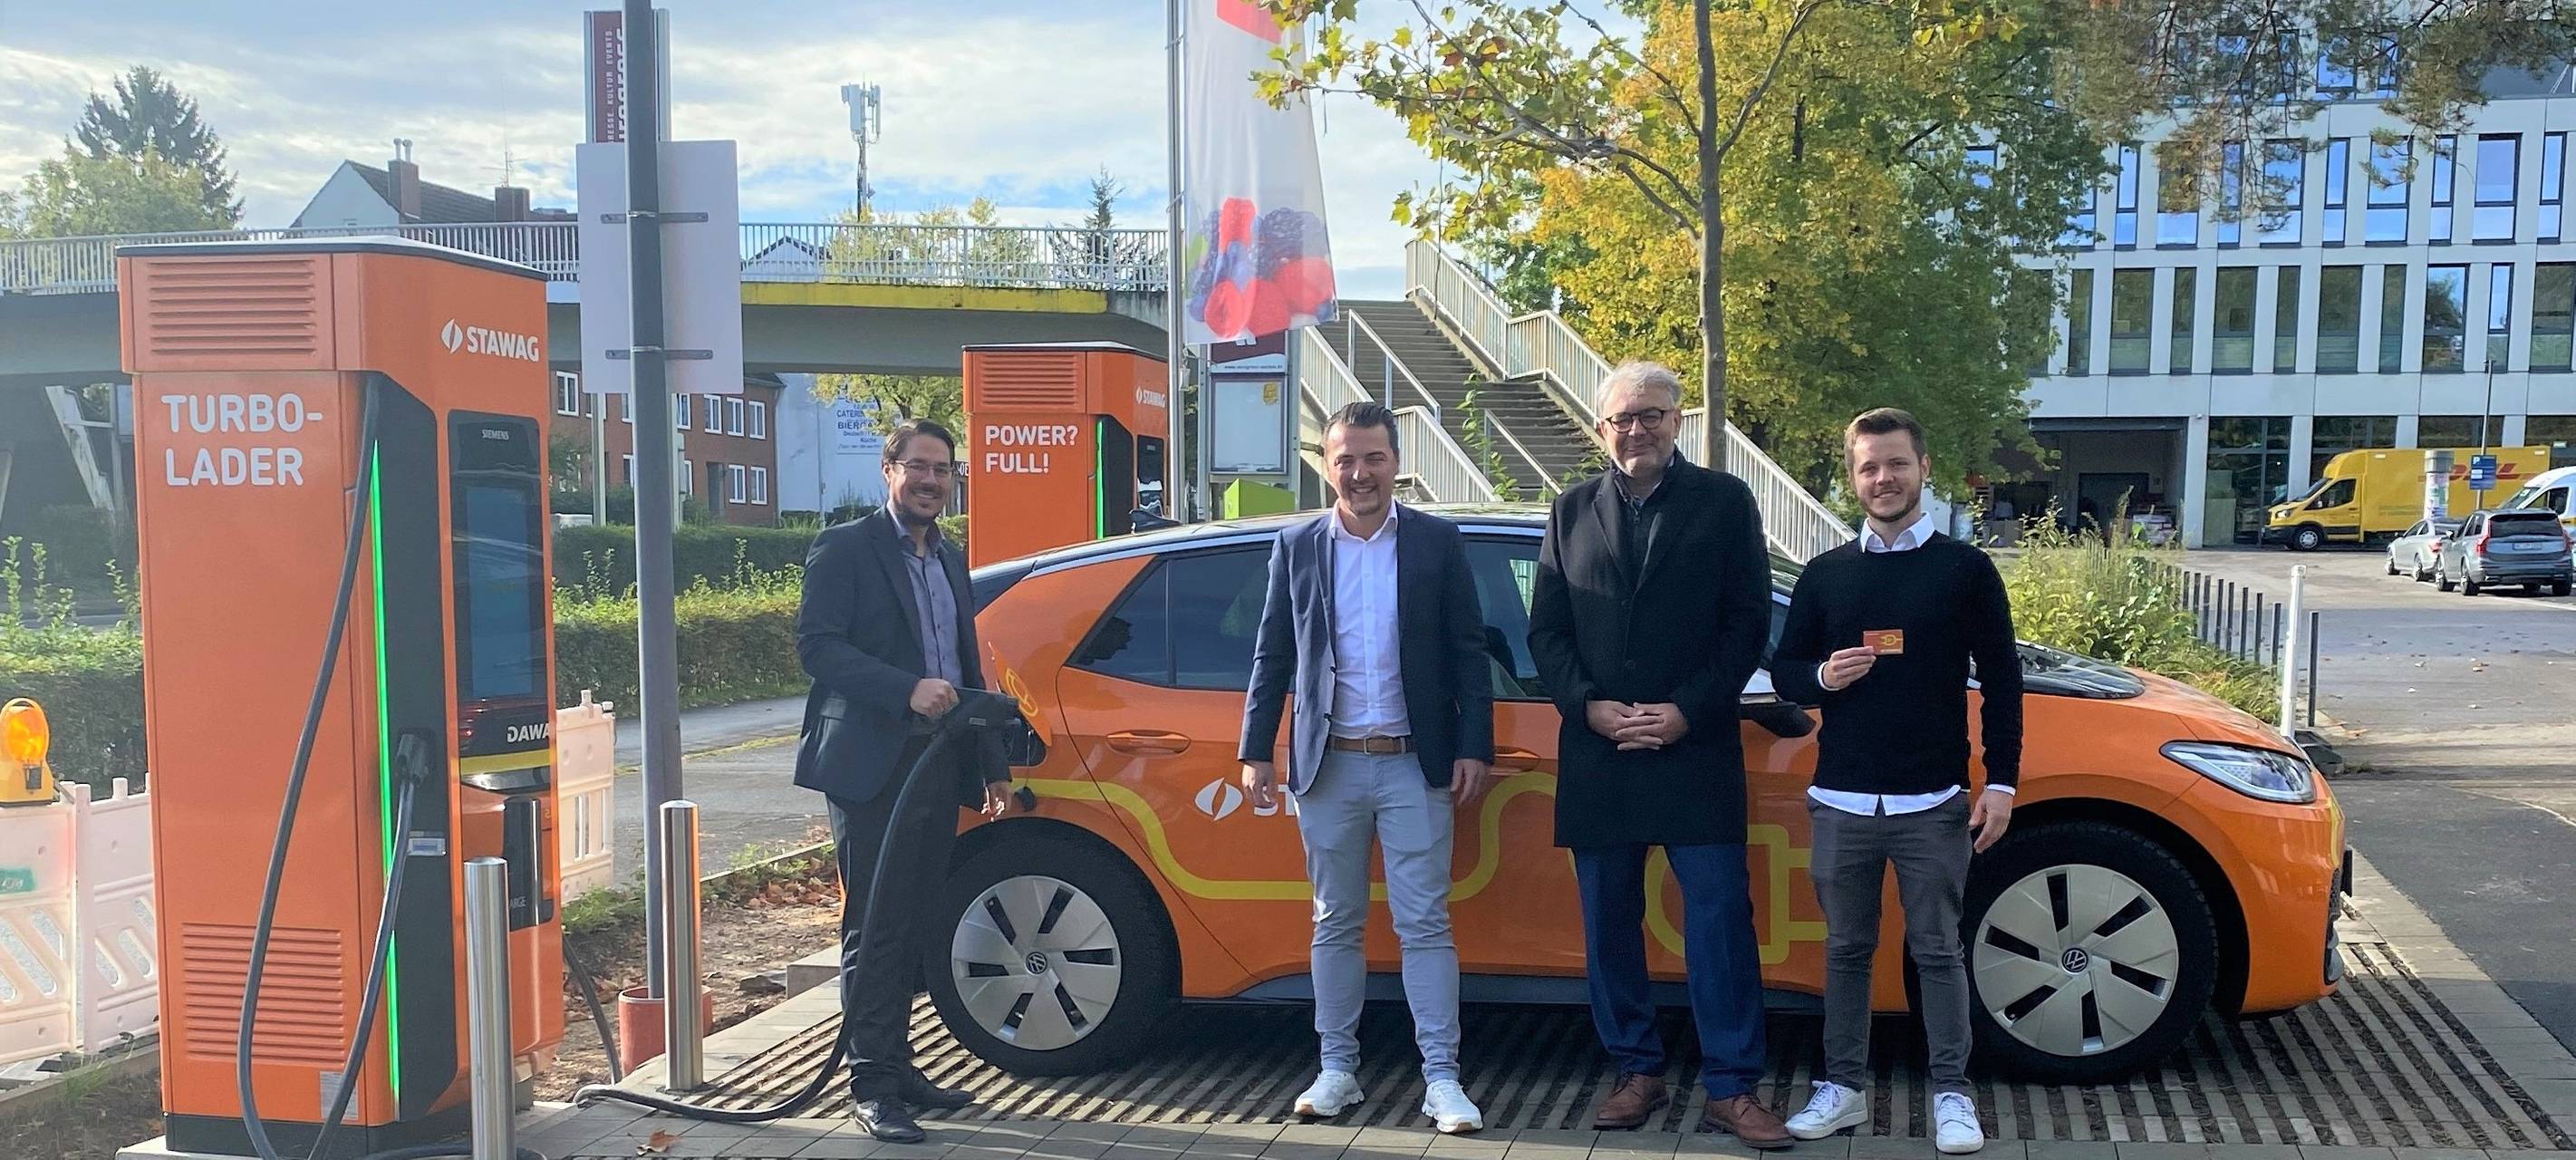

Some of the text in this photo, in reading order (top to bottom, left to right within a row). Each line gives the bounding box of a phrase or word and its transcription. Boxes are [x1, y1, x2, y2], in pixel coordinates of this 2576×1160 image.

[605, 72, 614, 105] KULTUR
[606, 111, 615, 143] RESSE
[467, 325, 540, 362] STAWAG
[160, 393, 323, 433] TURBO-
[482, 429, 509, 440] SIEMENS
[985, 425, 1079, 447] POWER?
[166, 448, 304, 487] LADER
[986, 452, 1049, 474] FULL!
[2449, 463, 2521, 480] DL
